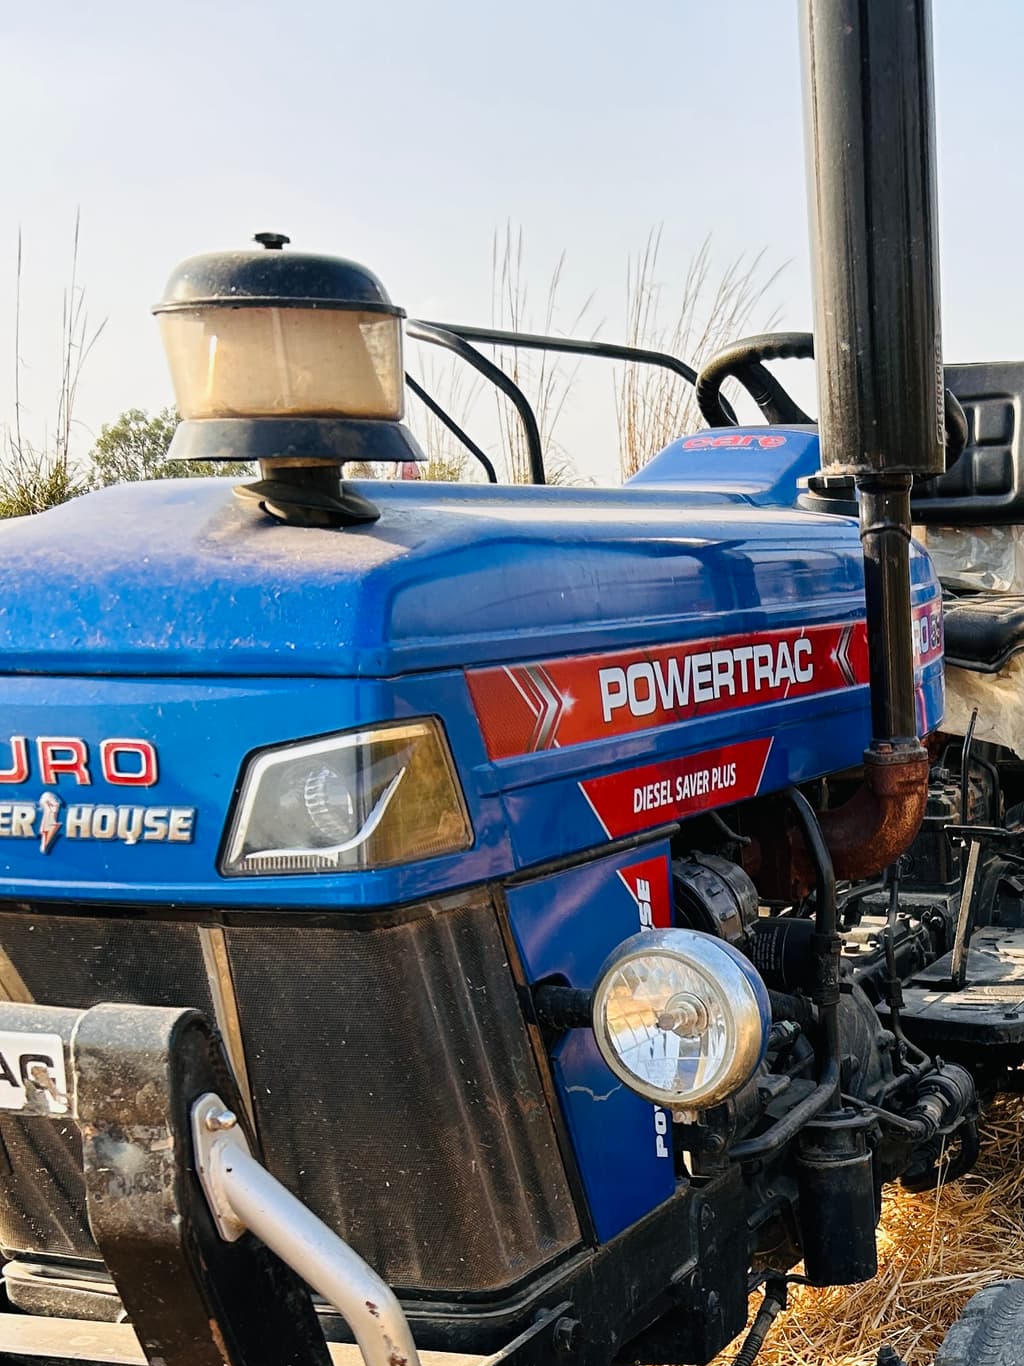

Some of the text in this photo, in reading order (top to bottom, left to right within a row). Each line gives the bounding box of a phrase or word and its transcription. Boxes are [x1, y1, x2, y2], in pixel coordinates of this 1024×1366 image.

[598, 638, 814, 723] POWERTRAC
[633, 762, 737, 814] DIESEL SAVER PLUS
[66, 803, 196, 845] HOUSE
[653, 1104, 669, 1158] PO
